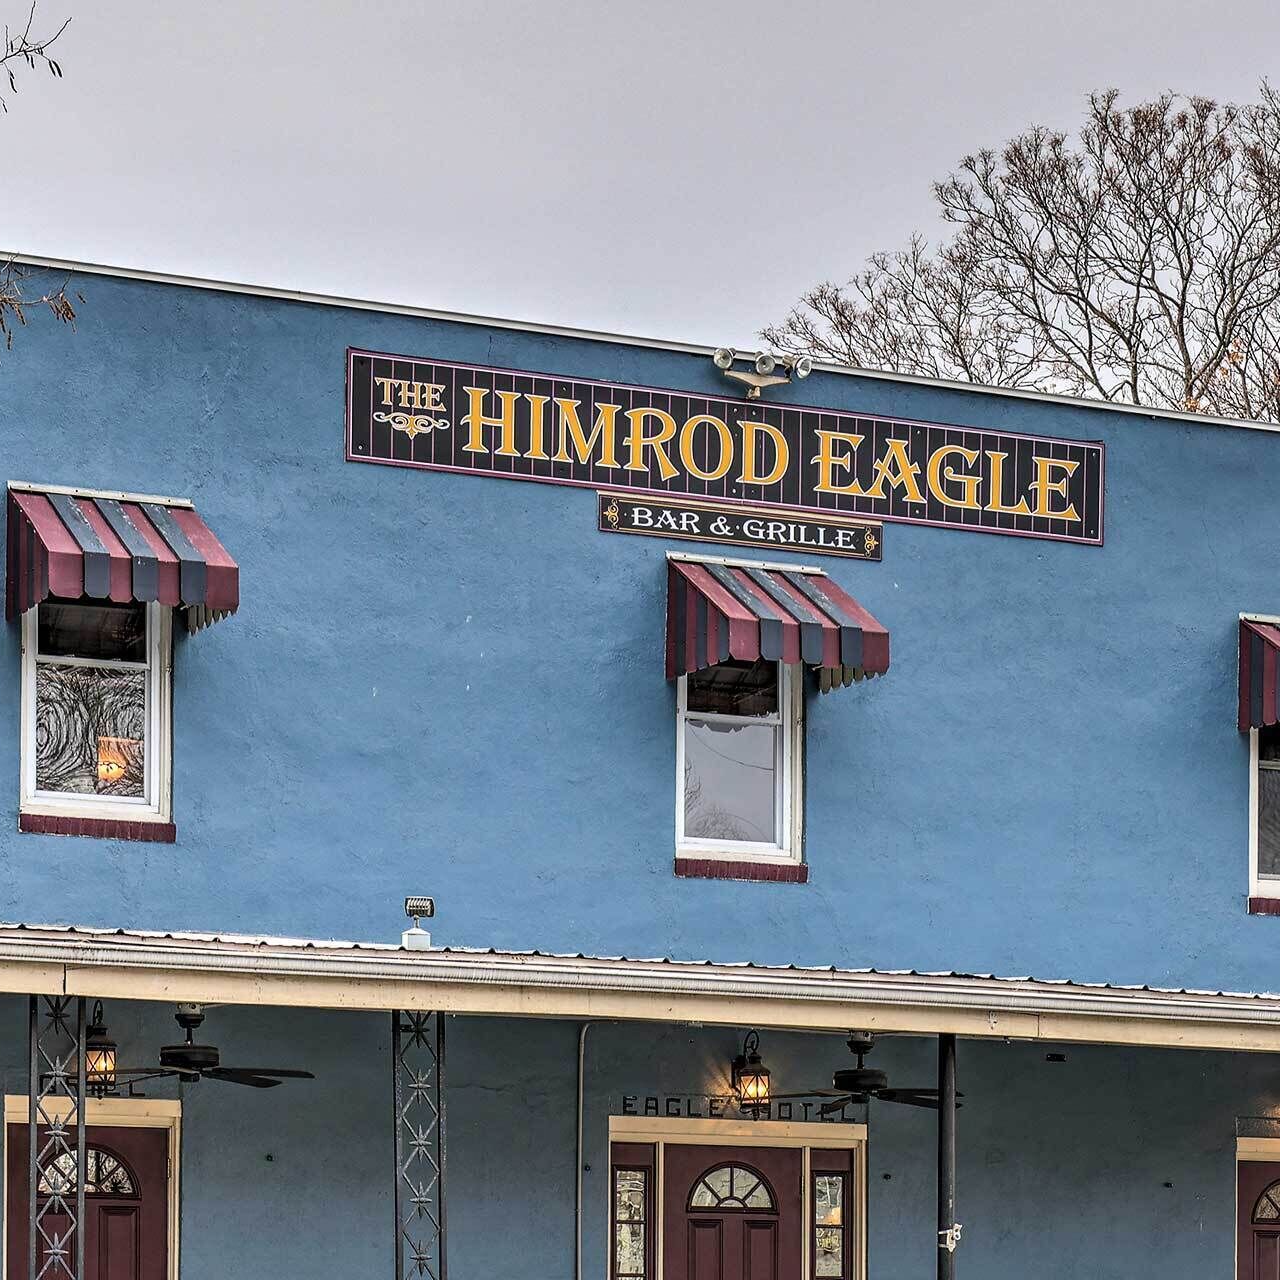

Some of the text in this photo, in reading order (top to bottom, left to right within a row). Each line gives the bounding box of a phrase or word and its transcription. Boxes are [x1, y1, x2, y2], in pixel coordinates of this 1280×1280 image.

[374, 376, 1082, 522] THE HIMROD EAGLE
[631, 506, 857, 550] BAR & GRILLE
[622, 1096, 724, 1118] EAGLE
